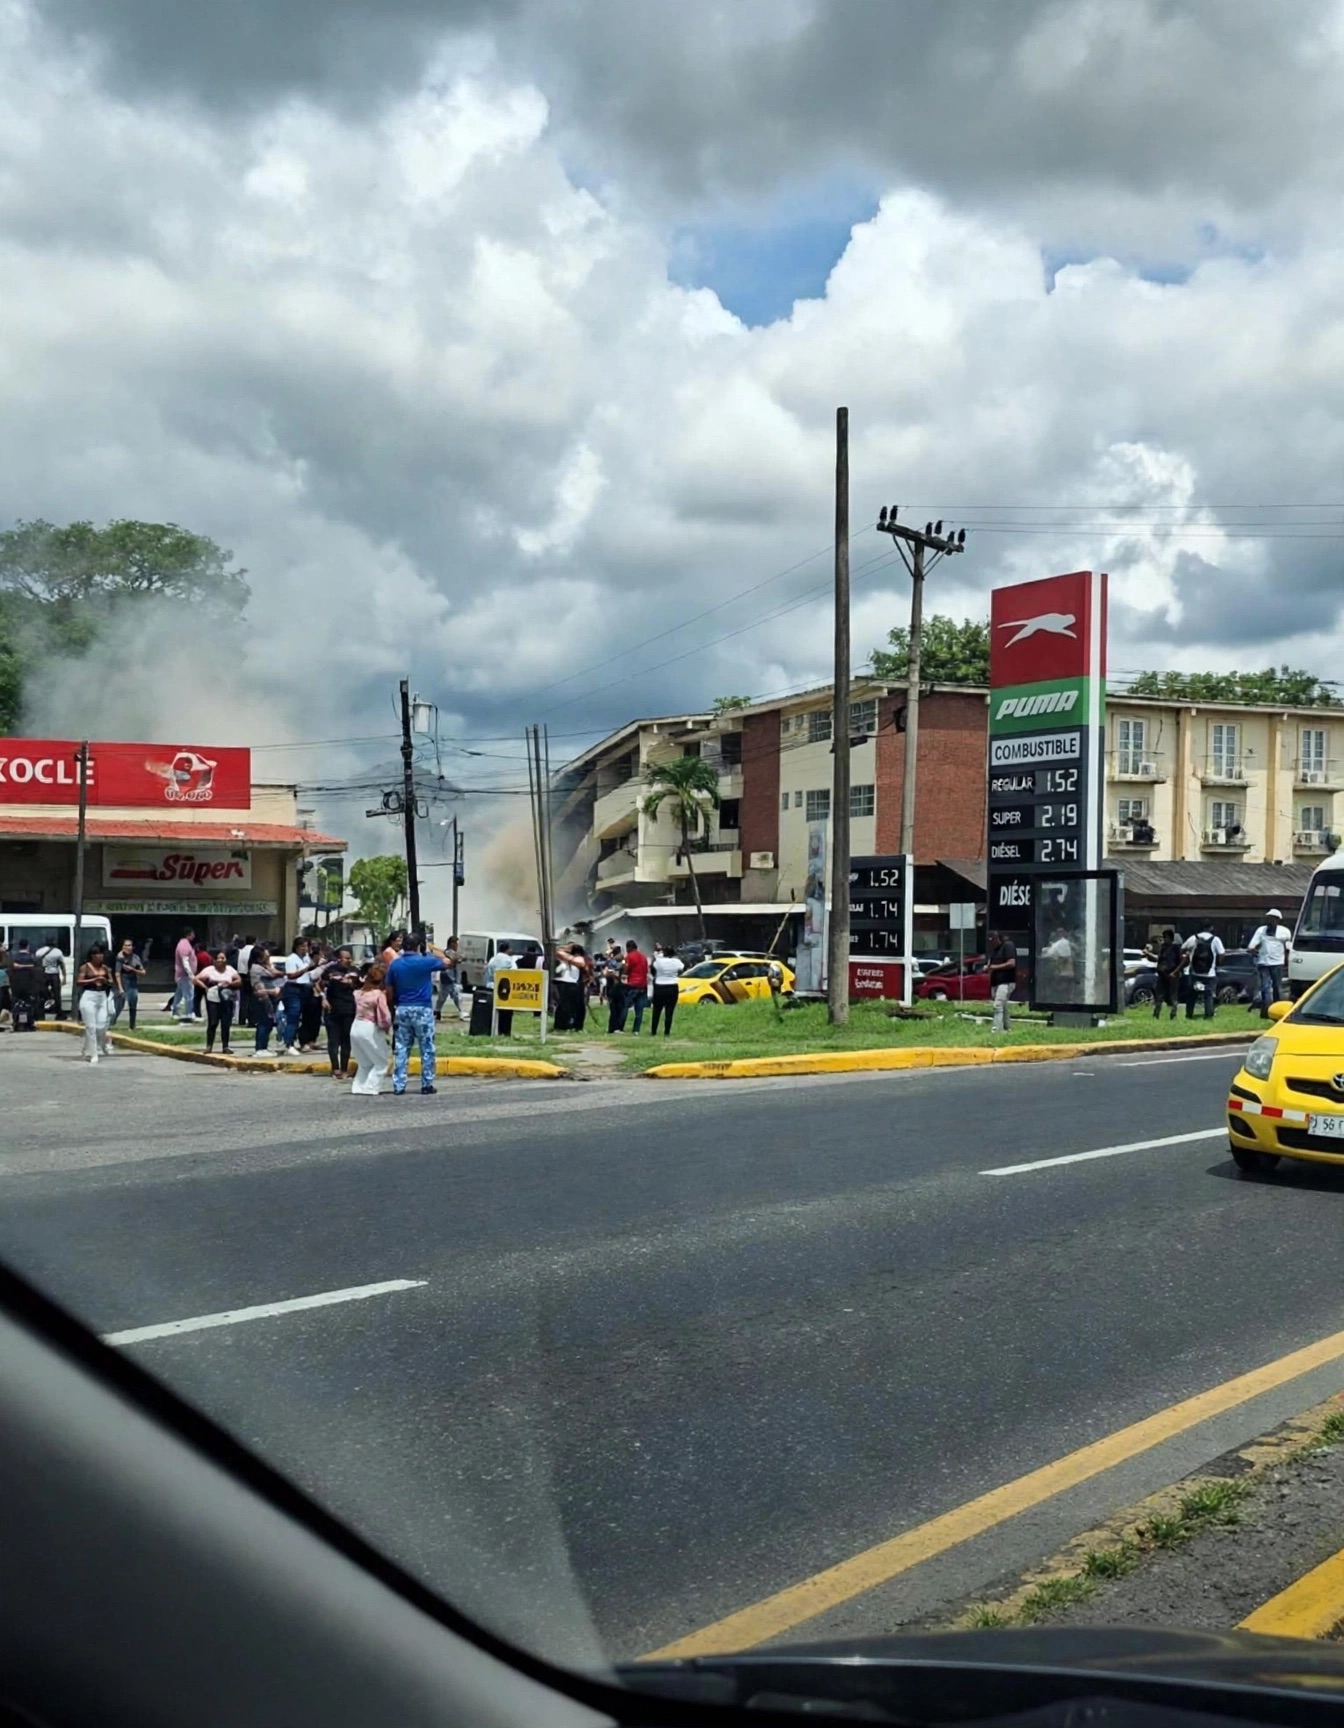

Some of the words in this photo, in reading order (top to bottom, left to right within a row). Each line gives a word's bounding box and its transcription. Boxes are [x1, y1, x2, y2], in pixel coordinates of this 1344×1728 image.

[995, 690, 1079, 720] PUMA
[994, 738, 1077, 760] COMBUSTIBLE
[991, 776, 1033, 792] REGULAR
[1047, 769, 1078, 792] 1.52
[992, 811, 1022, 825] SUPER
[1041, 804, 1077, 827] 2.19
[991, 842, 1021, 858] DIÉSEL
[1041, 839, 1077, 862] 2.74
[870, 869, 899, 887] 1.52
[870, 900, 898, 918] 1.74
[869, 931, 898, 949] 1.74
